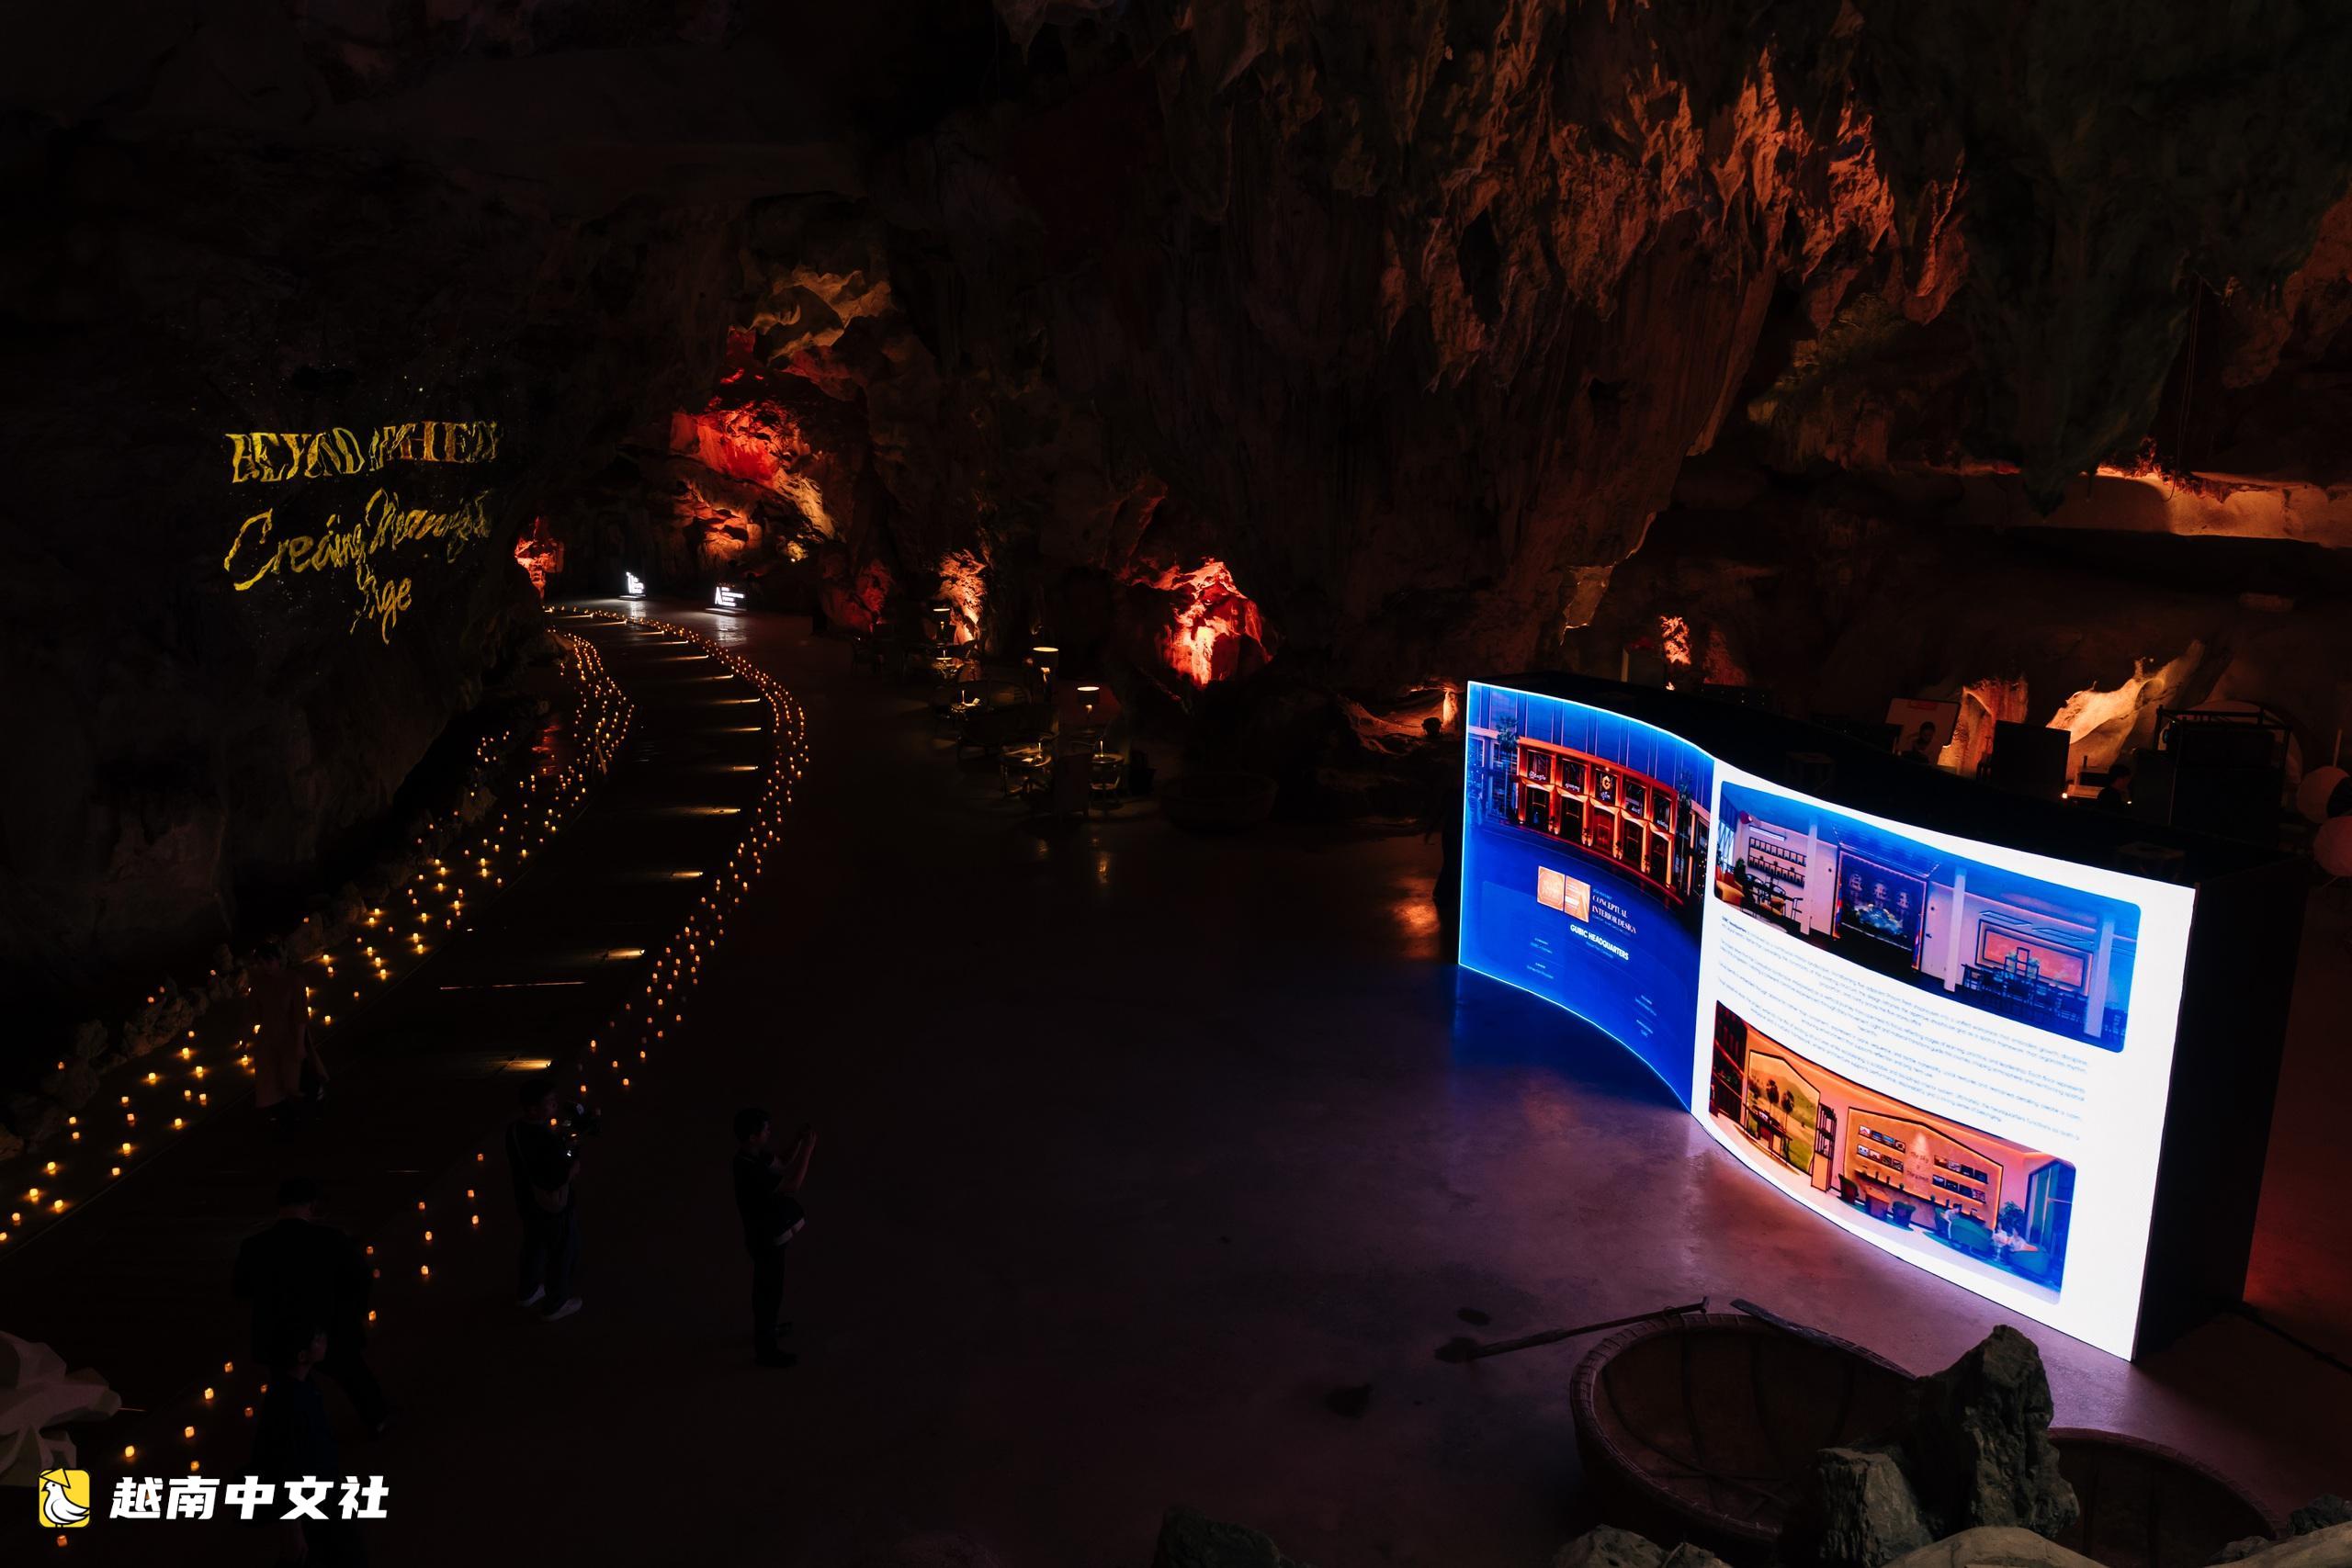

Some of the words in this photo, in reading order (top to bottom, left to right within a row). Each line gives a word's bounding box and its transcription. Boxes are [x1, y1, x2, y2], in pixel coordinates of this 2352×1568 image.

[1592, 895, 1628, 919] CONCEPTUAL
[1592, 905, 1617, 924] INTERIOR
[1618, 919, 1636, 934] DESIGN
[1588, 931, 1629, 961] HEADQUARTERS
